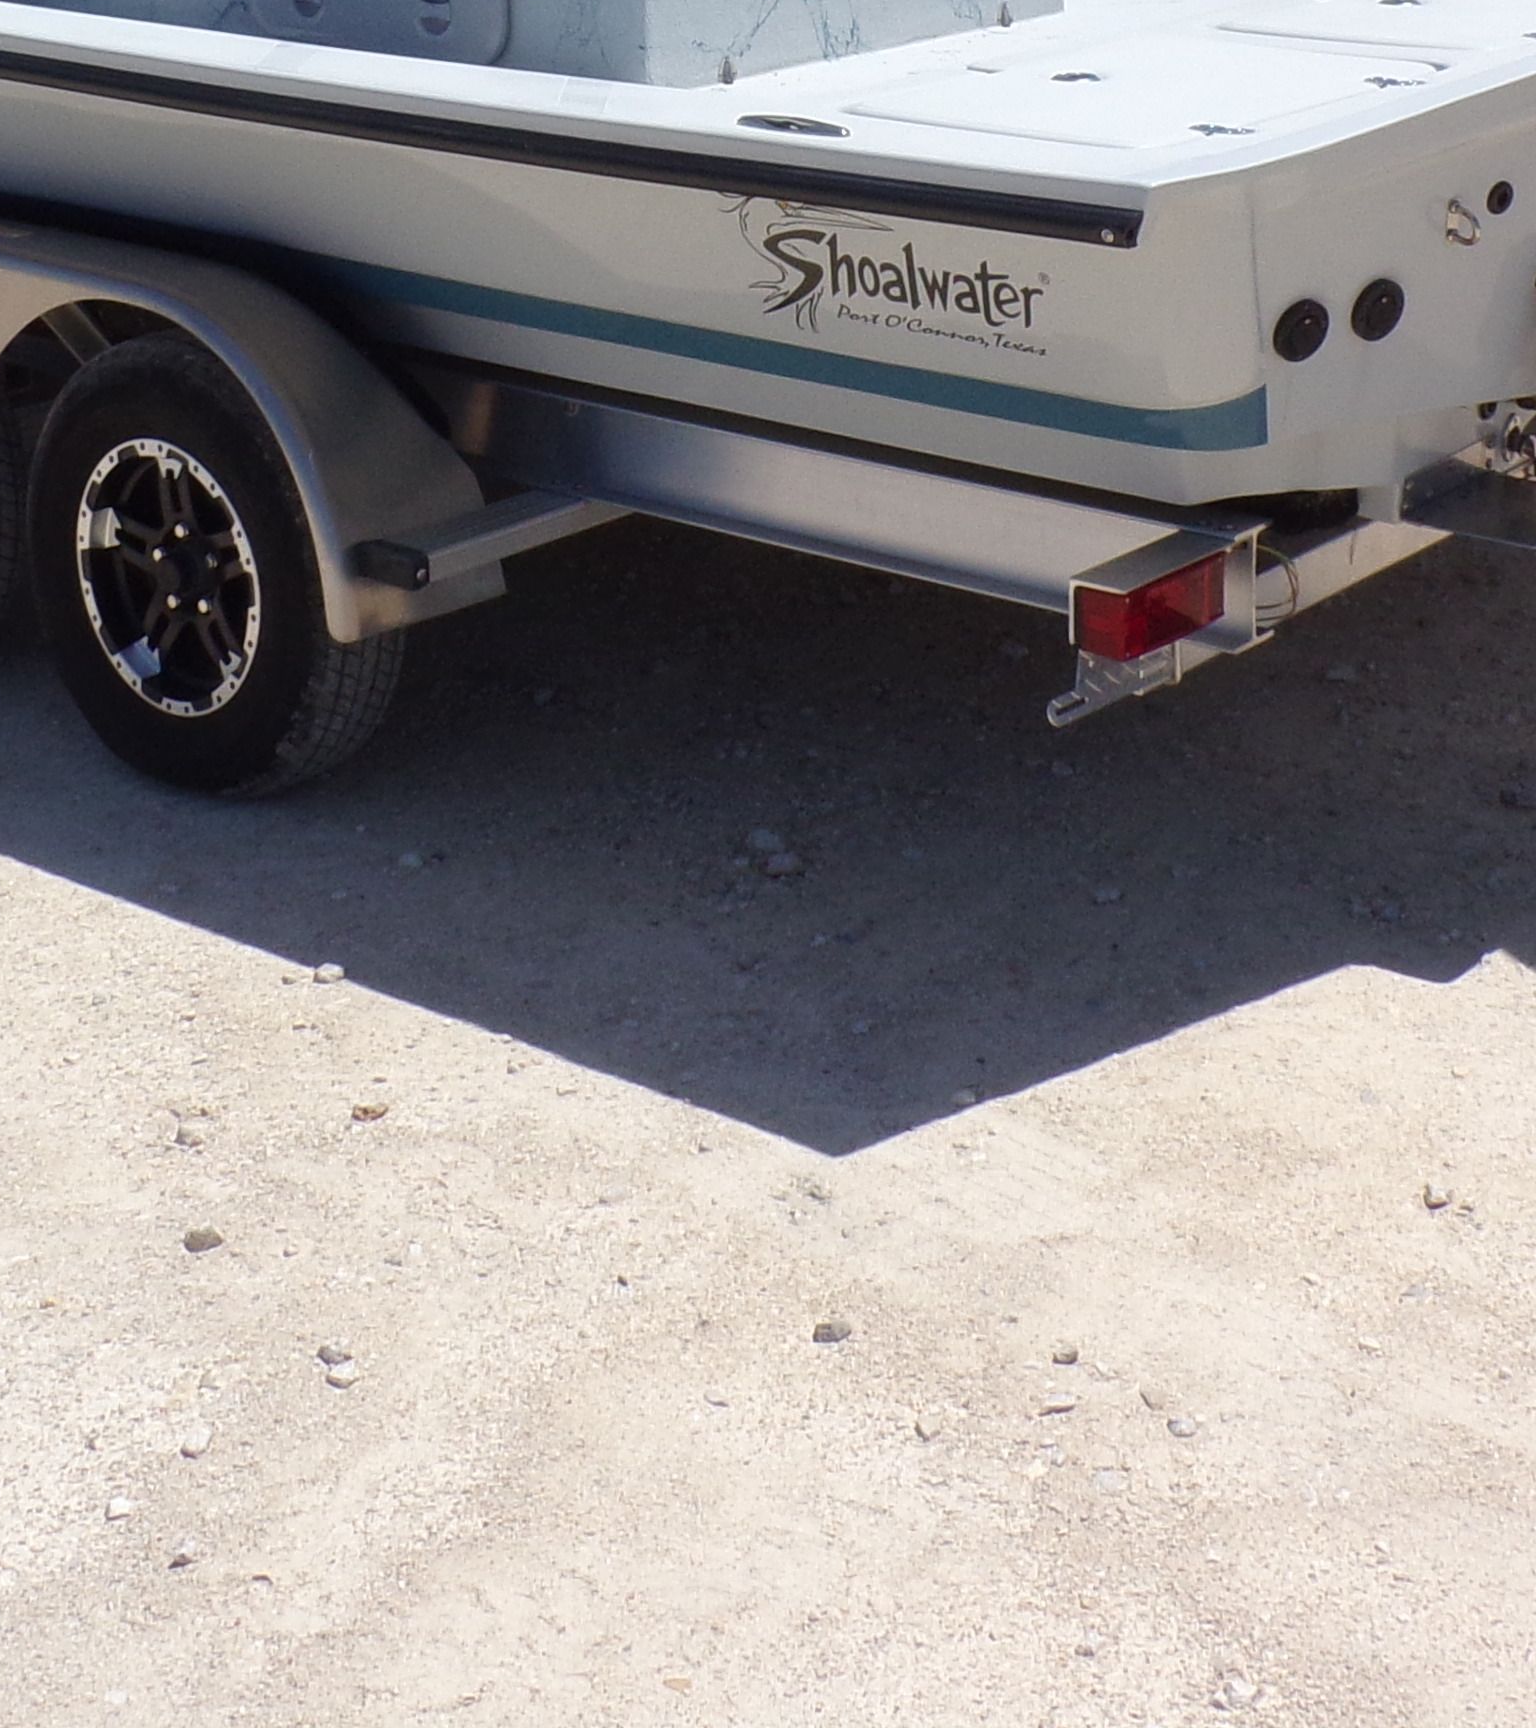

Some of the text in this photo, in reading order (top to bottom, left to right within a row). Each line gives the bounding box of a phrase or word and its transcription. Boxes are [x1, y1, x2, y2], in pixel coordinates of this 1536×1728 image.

[763, 228, 1044, 329] Shoalwater
[837, 303, 1048, 357] Port O'Connor, Texas
